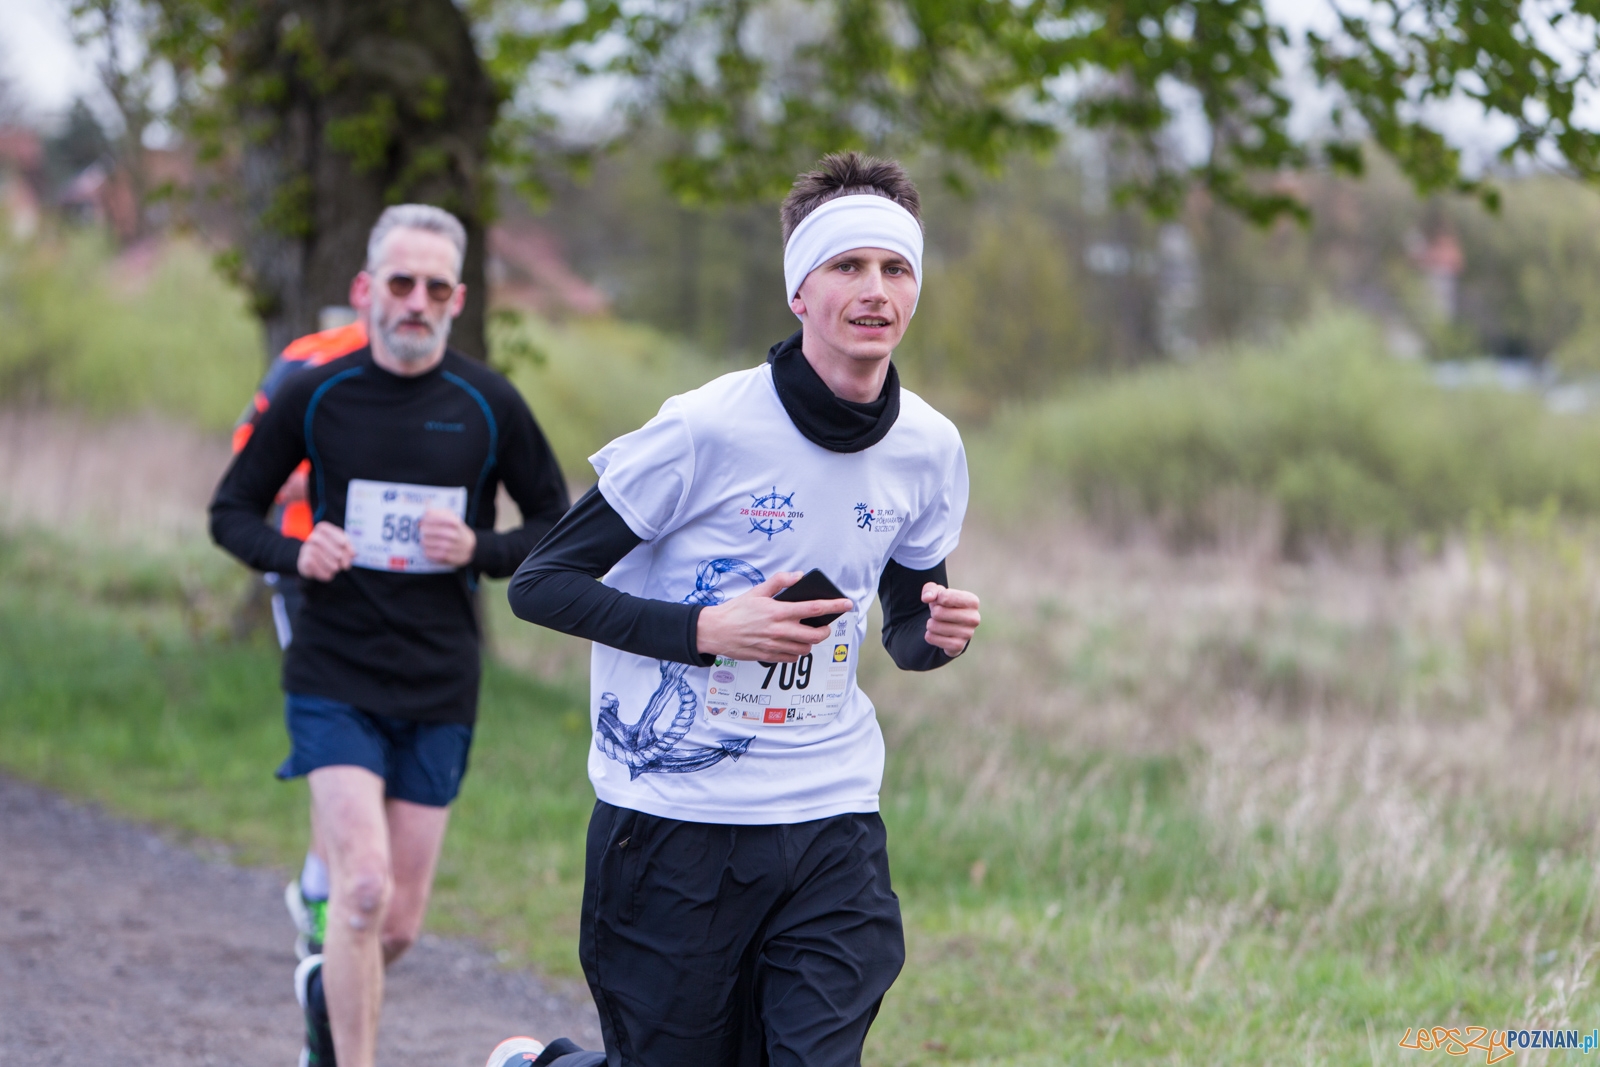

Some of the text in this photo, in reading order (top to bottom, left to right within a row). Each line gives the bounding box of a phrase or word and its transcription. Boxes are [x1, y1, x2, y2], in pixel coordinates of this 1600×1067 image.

[751, 509, 786, 517] SIERPNIA
[758, 652, 813, 690] 709
[734, 692, 759, 704] 5KM
[801, 693, 824, 703] 10KM
